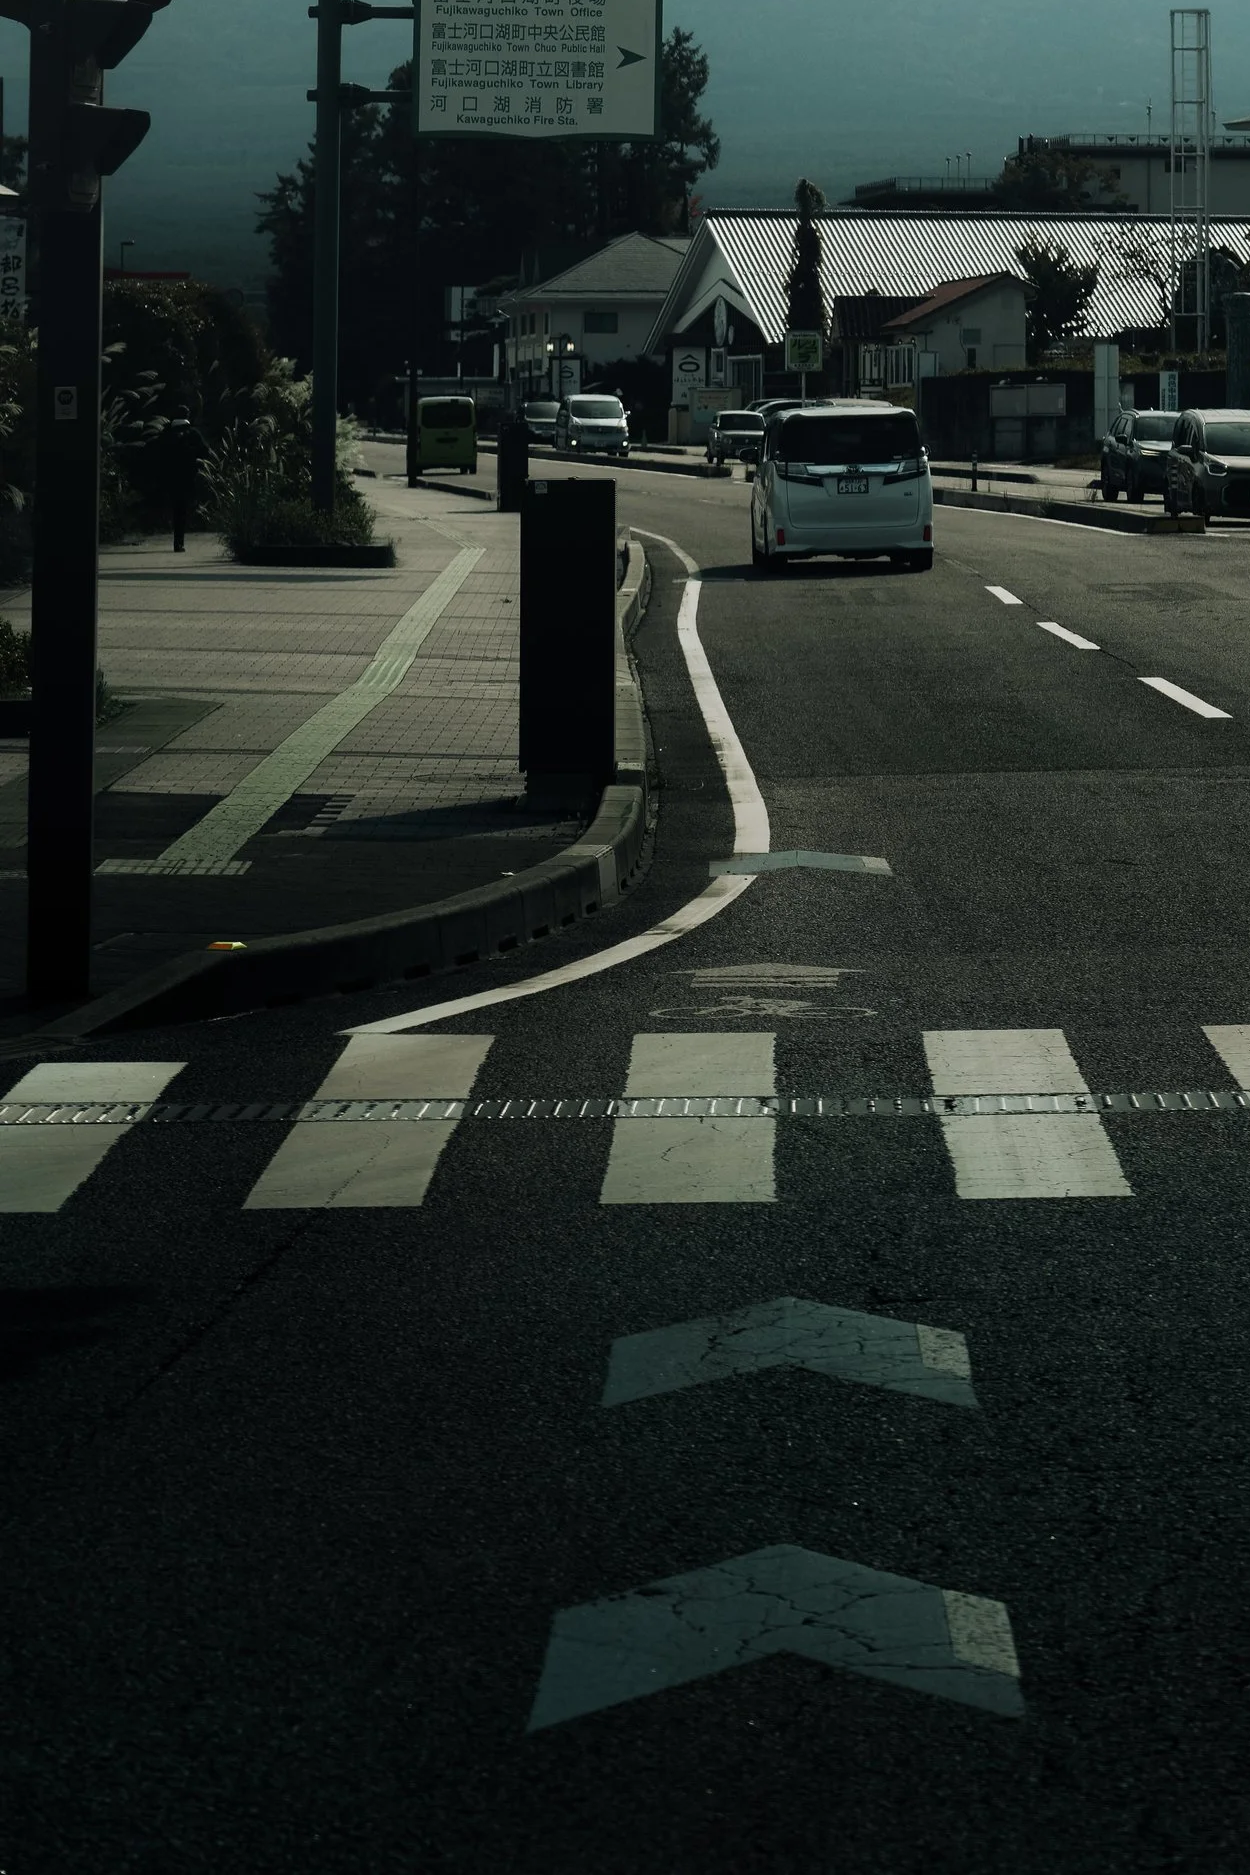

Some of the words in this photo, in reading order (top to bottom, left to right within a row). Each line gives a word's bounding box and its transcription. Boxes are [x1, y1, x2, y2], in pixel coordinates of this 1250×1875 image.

[435, 5, 528, 17] Fujikawaguchiko
[535, 6, 564, 17] Town
[570, 7, 603, 17] Office
[431, 22, 605, 42] 富士河口湖町中央公民館
[431, 41, 502, 53] Fujikawaguchiko
[507, 43, 530, 53] Town
[534, 43, 557, 53] Chuo
[561, 44, 588, 54] Public
[589, 44, 606, 54] Hall
[431, 58, 605, 79] 富士河口湖町立図書館
[431, 78, 524, 90] Fujikawaguchiko
[530, 79, 560, 90] Town
[566, 80, 604, 92] Library
[430, 95, 604, 115] 河口湖消防署
[456, 114, 531, 127] Kawaguchiko
[533, 115, 555, 126] Fire
[557, 115, 578, 126] Sta.
